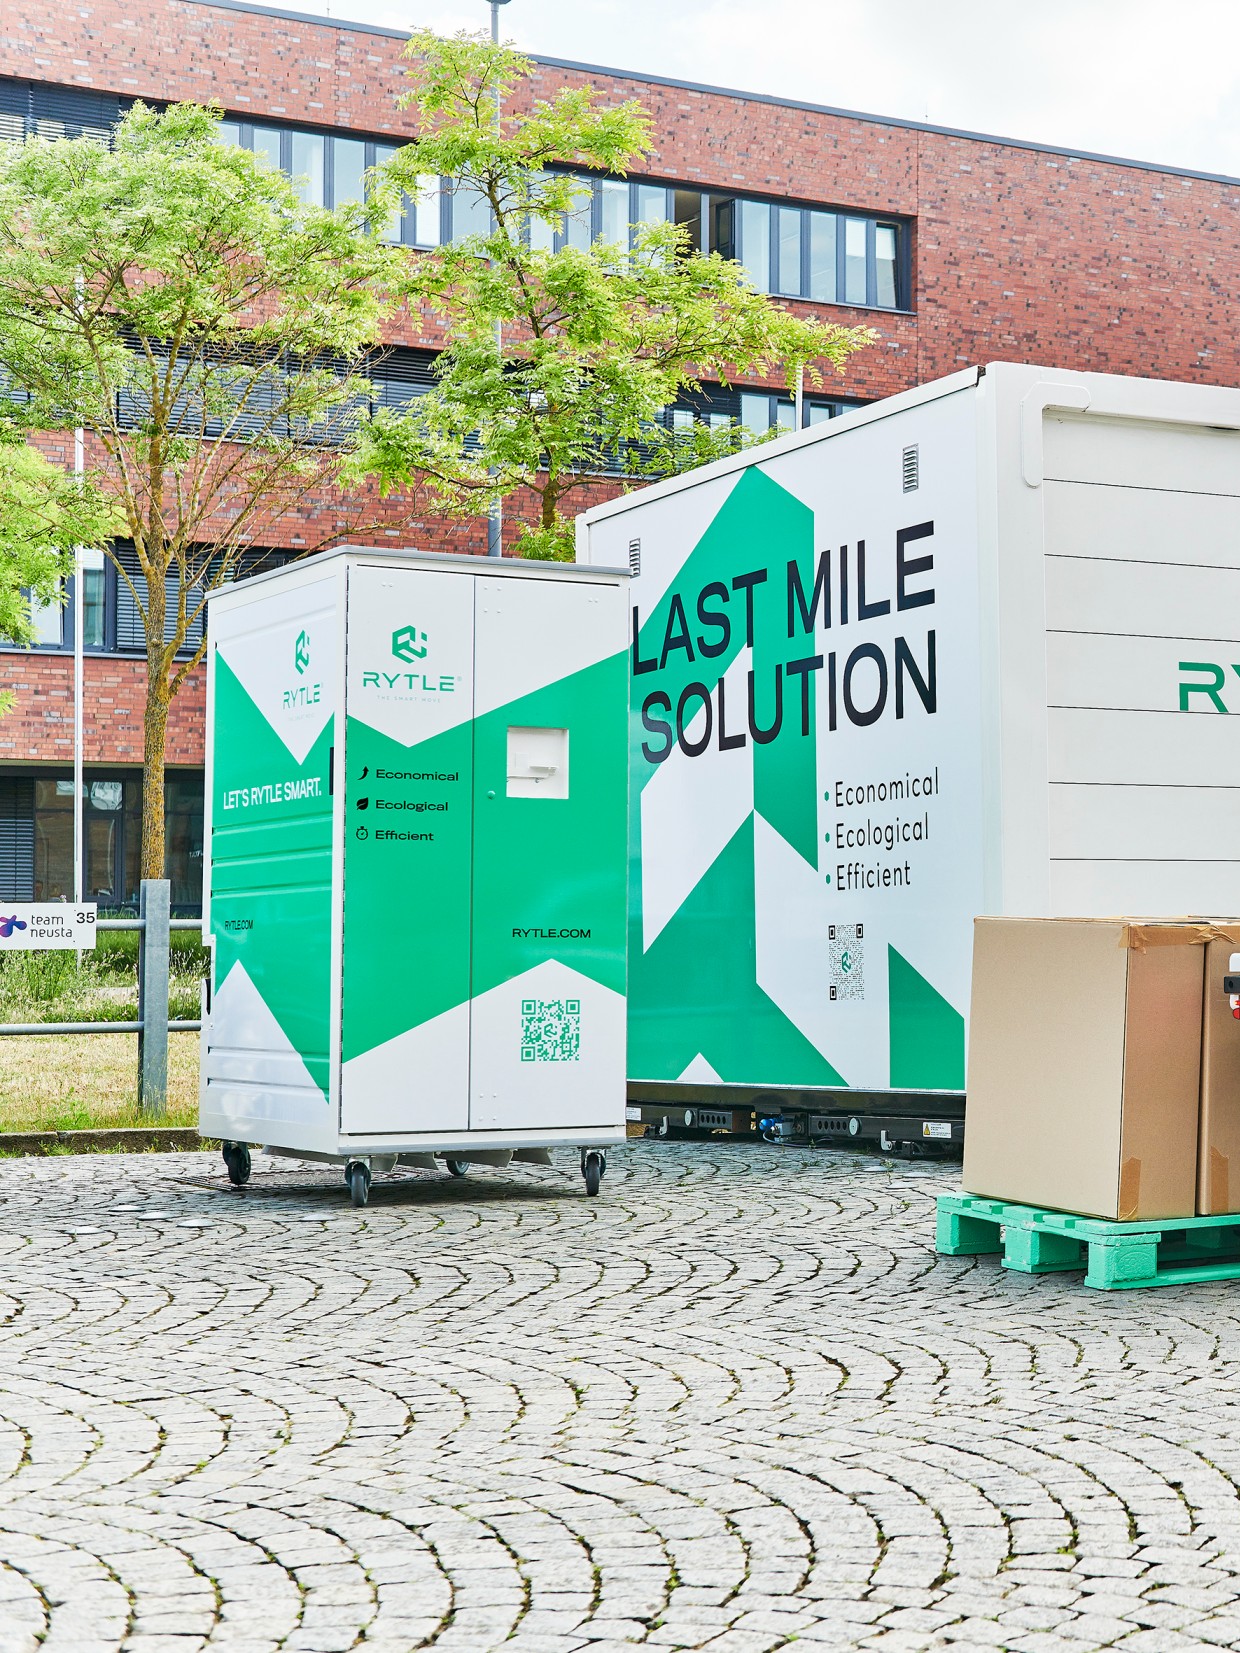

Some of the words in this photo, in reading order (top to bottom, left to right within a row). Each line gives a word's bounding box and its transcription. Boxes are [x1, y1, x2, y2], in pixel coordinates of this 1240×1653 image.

[632, 567, 768, 677] LAST
[786, 519, 935, 640] MILE
[362, 671, 455, 692] RYTLE
[283, 684, 321, 710] RYTLE
[641, 628, 937, 764] SOLUTION
[376, 769, 459, 781] Economical
[223, 788, 249, 810] LET'S
[251, 783, 282, 806] RYTLE
[284, 777, 322, 801] SMART.
[835, 766, 939, 808] Economical
[375, 799, 449, 812] Ecological
[375, 829, 434, 841] Efficient
[836, 811, 929, 851] Ecological
[836, 860, 911, 891] Efficient
[31, 914, 64, 926] team
[76, 912, 95, 924] 35
[224, 919, 254, 930] RYTLE.COM
[30, 927, 73, 938] neusta
[512, 928, 591, 939] RYTLE.COM
